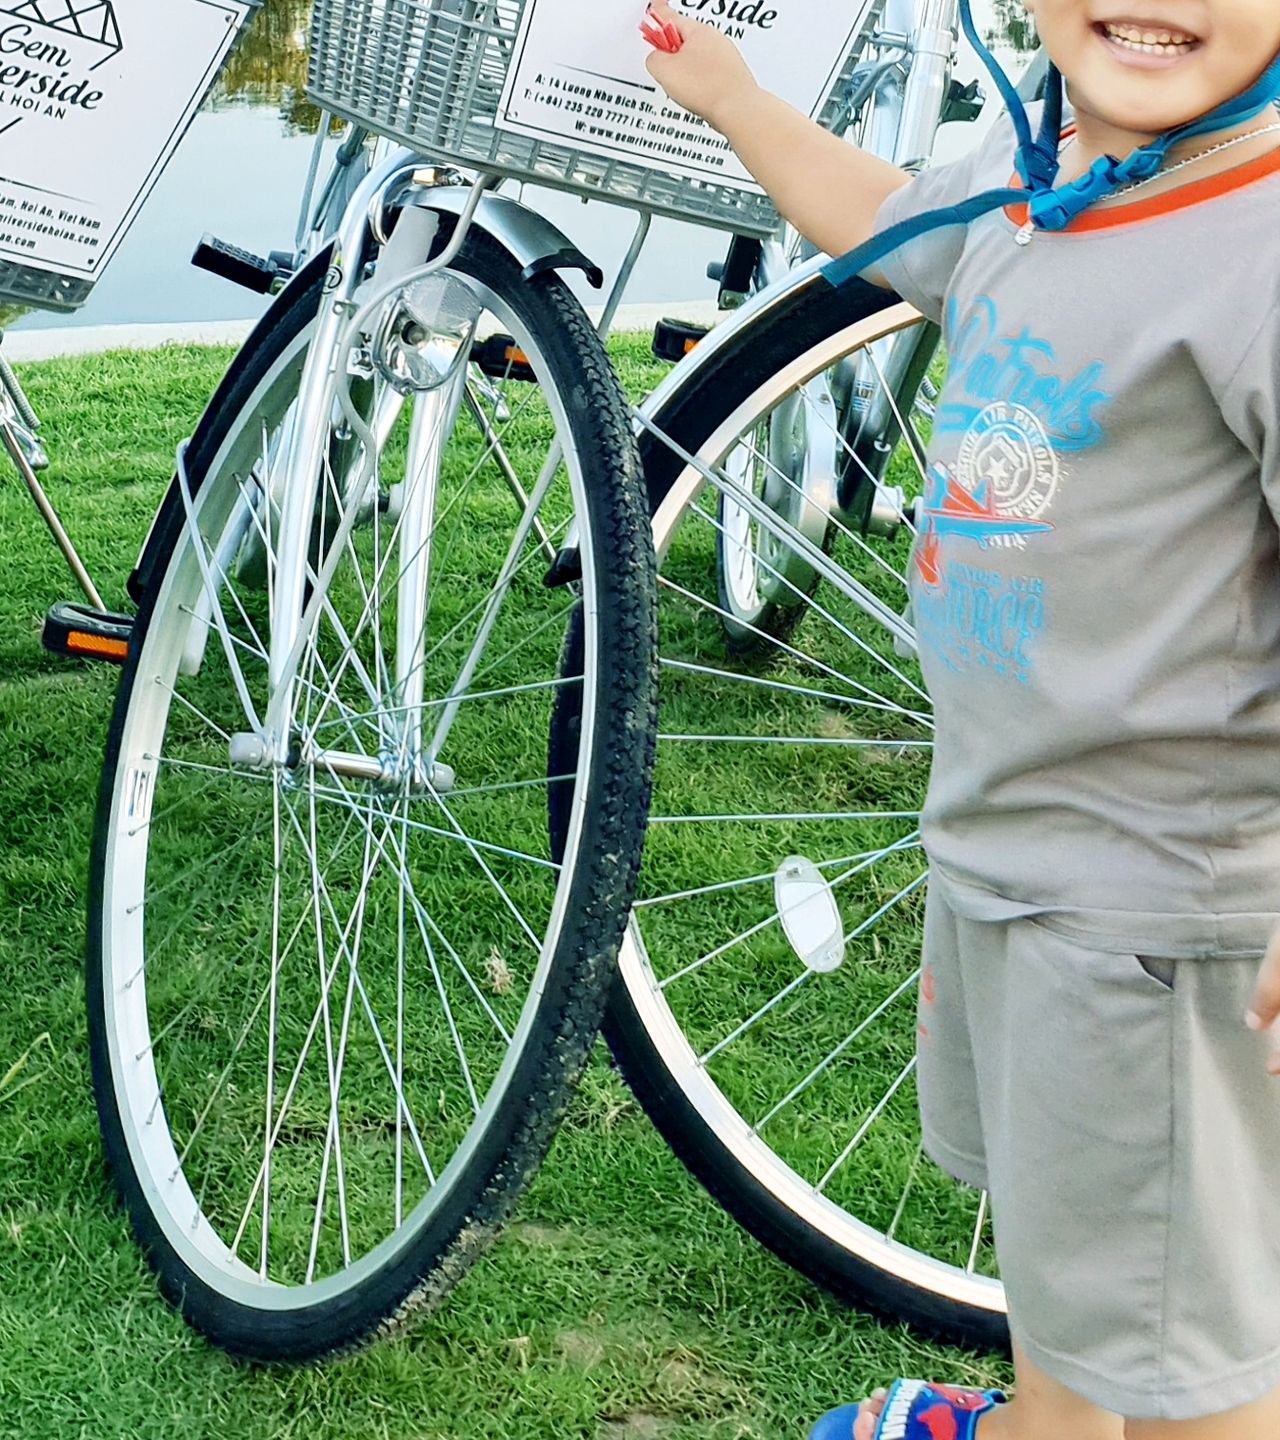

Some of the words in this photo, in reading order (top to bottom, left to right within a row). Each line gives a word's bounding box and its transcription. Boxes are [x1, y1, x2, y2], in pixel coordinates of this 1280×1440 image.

[723, 26, 746, 40] AN
[9, 93, 41, 113] HOI
[43, 104, 67, 120] AN
[534, 92, 563, 109] (+84)
[564, 100, 584, 113] 235
[584, 105, 604, 119] 220
[605, 109, 630, 125] 7777
[549, 77, 560, 89] 14
[562, 80, 592, 99] Luong
[593, 89, 614, 103] Nhu
[614, 94, 637, 110] Bich
[660, 106, 682, 121] Cam
[20, 200, 39, 213] Hoi
[58, 209, 78, 224] Viet
[78, 215, 101, 230] Nam
